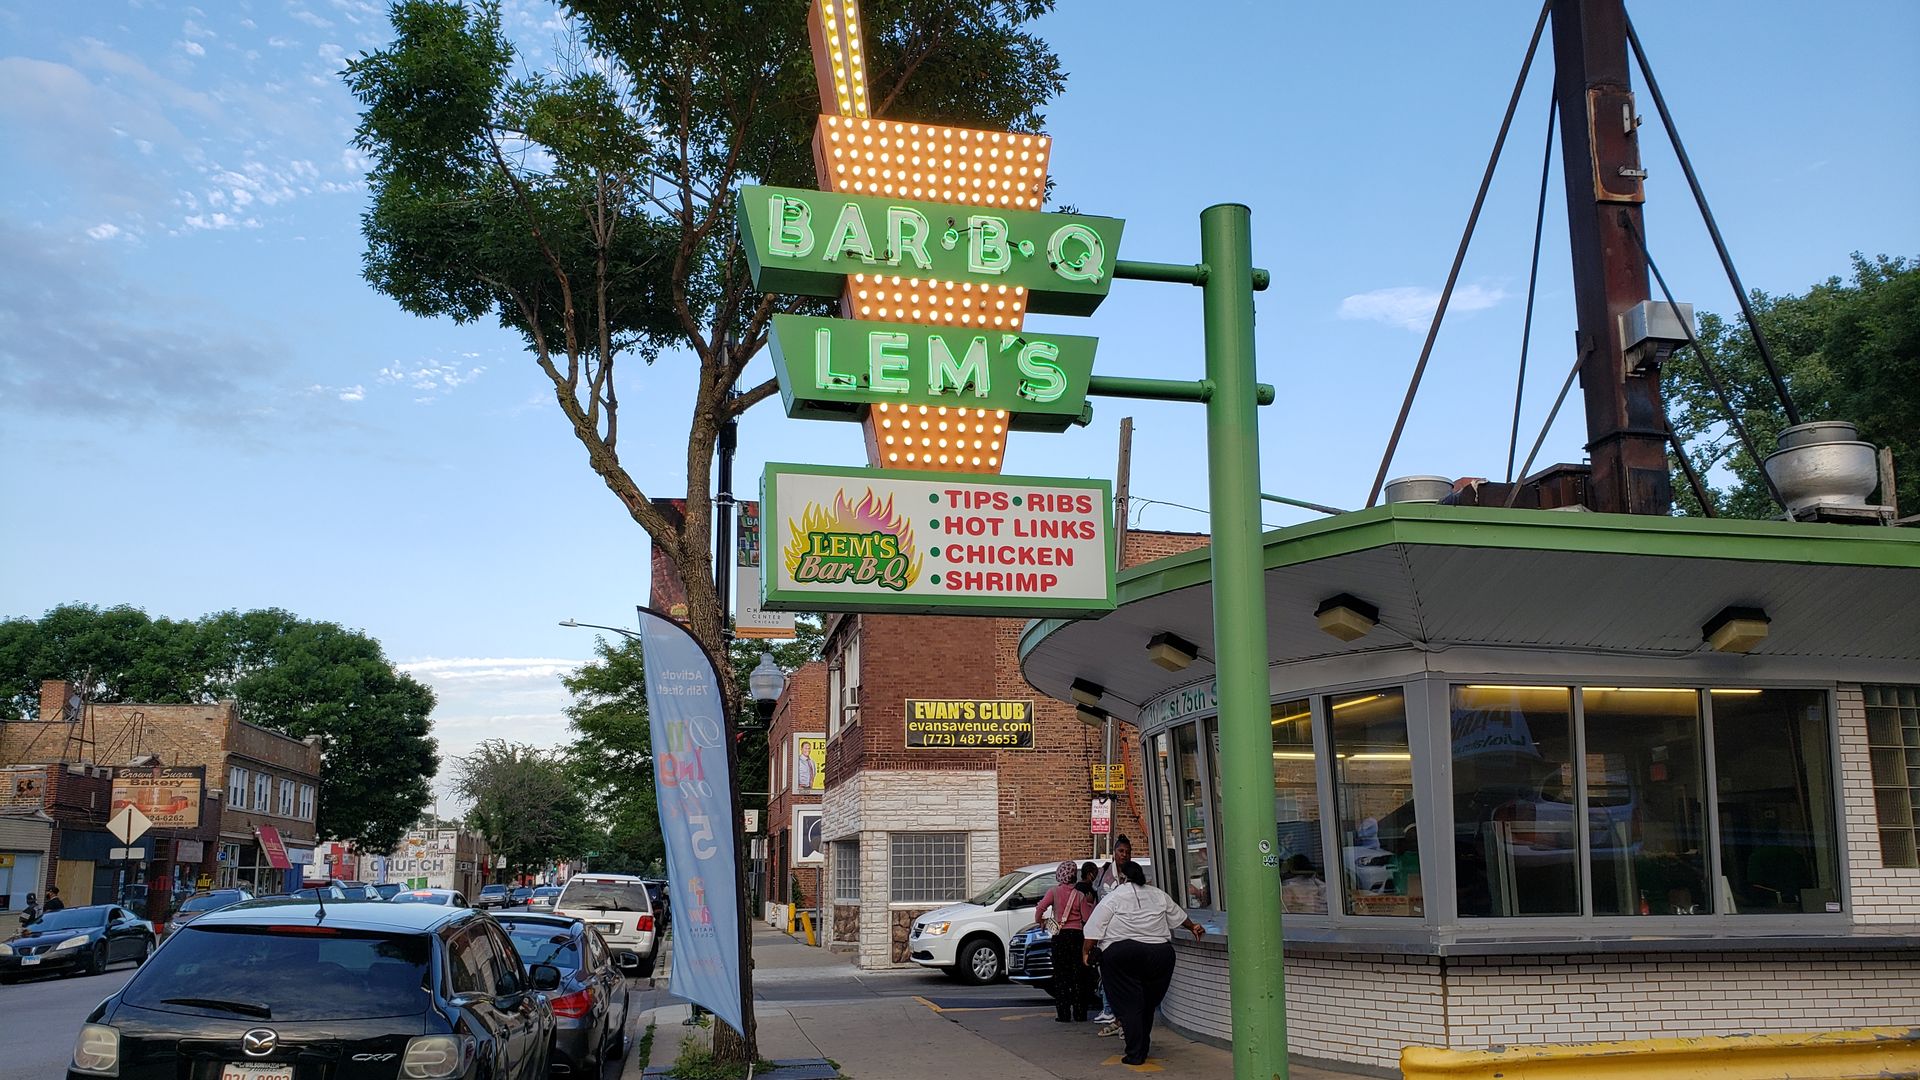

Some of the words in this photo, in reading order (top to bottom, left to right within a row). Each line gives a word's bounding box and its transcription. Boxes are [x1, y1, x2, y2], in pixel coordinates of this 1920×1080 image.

[815, 328, 1067, 402] LEM'S
[944, 490, 1009, 511] TIPS
[1027, 493, 1093, 514] RIBS
[944, 516, 1004, 536] HOT
[1014, 518, 1096, 540] LINKS
[812, 534, 896, 559] LEM'S
[945, 544, 1074, 567] CHICKEN
[799, 555, 905, 588] Bar-B-Q
[946, 570, 1057, 592] SHRIMP
[915, 701, 976, 720] EVAN'S
[980, 702, 1025, 720] CLUB
[1182, 688, 1206, 714] 75th
[909, 721, 1031, 732] evansavenue.com
[923, 734, 955, 746] (773)
[960, 734, 1018, 745] 487-9653
[120, 768, 153, 778] Brown
[161, 768, 193, 778] Sugar
[130, 779, 184, 787] Bakery
